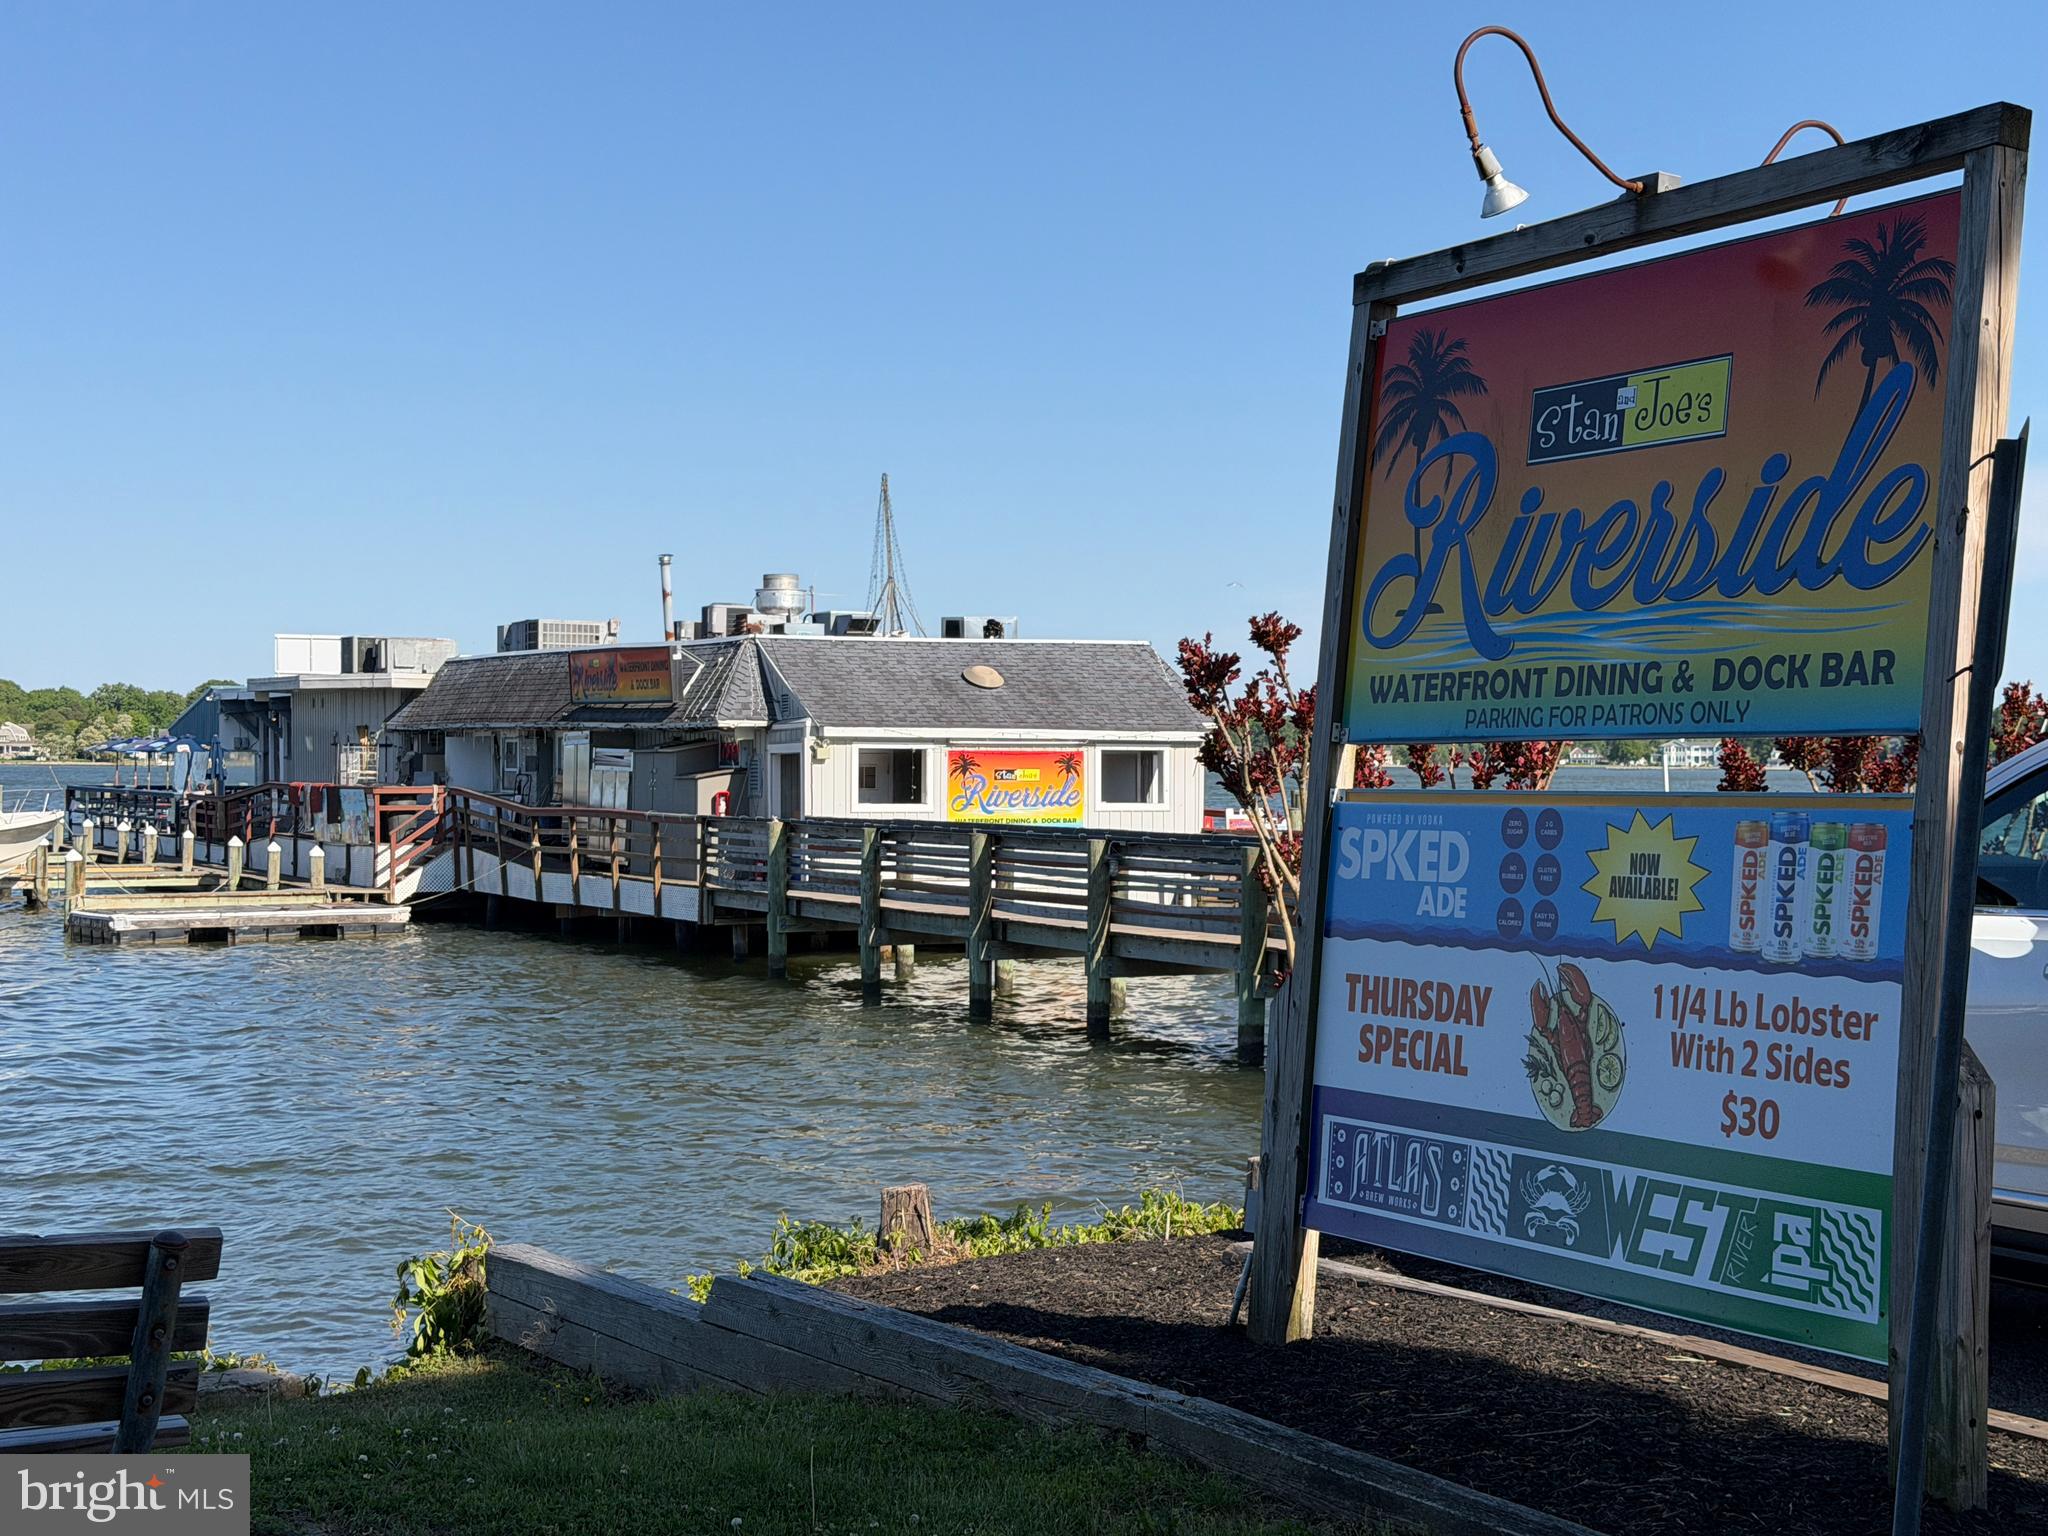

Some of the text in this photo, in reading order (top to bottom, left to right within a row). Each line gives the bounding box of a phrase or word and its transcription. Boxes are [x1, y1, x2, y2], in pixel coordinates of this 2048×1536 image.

[1536, 375, 1712, 448] Stan and Joe's
[1362, 361, 1935, 661] Riverside
[1369, 649, 1897, 704] WATERFRONT DINING & DOCK BAR
[1465, 700, 1750, 729] PARKING FOR PATRONS ONLY
[951, 774, 1080, 815] Riverside
[1366, 814, 1443, 825] POWERED BY VODKA
[1608, 875, 1679, 901] AVAILABLE!
[1630, 852, 1661, 876] NOW
[1739, 850, 1758, 931] SPKED
[1758, 851, 1767, 880] ADE
[1797, 847, 1807, 881] ADE
[1835, 853, 1845, 884] ADE
[1873, 855, 1884, 885] ADE
[1416, 885, 1468, 919] ADE
[1773, 846, 1797, 939] SPKED
[1813, 852, 1836, 936] SPKED
[1850, 854, 1874, 938] SPKED
[1345, 972, 1493, 1027] THURSDAY
[1713, 989, 1748, 1028] Lb
[1755, 992, 1879, 1041] Lobster
[1358, 1023, 1468, 1077] SPECIAL
[1670, 1031, 1850, 1089] With 2 Sides
[1720, 1089, 1780, 1140] $30
[1350, 1129, 1444, 1217] ATLAS
[1365, 1190, 1412, 1209] BREW WORKS
[1601, 1168, 1760, 1283] WEST
[1726, 1214, 1758, 1284] RIVER
